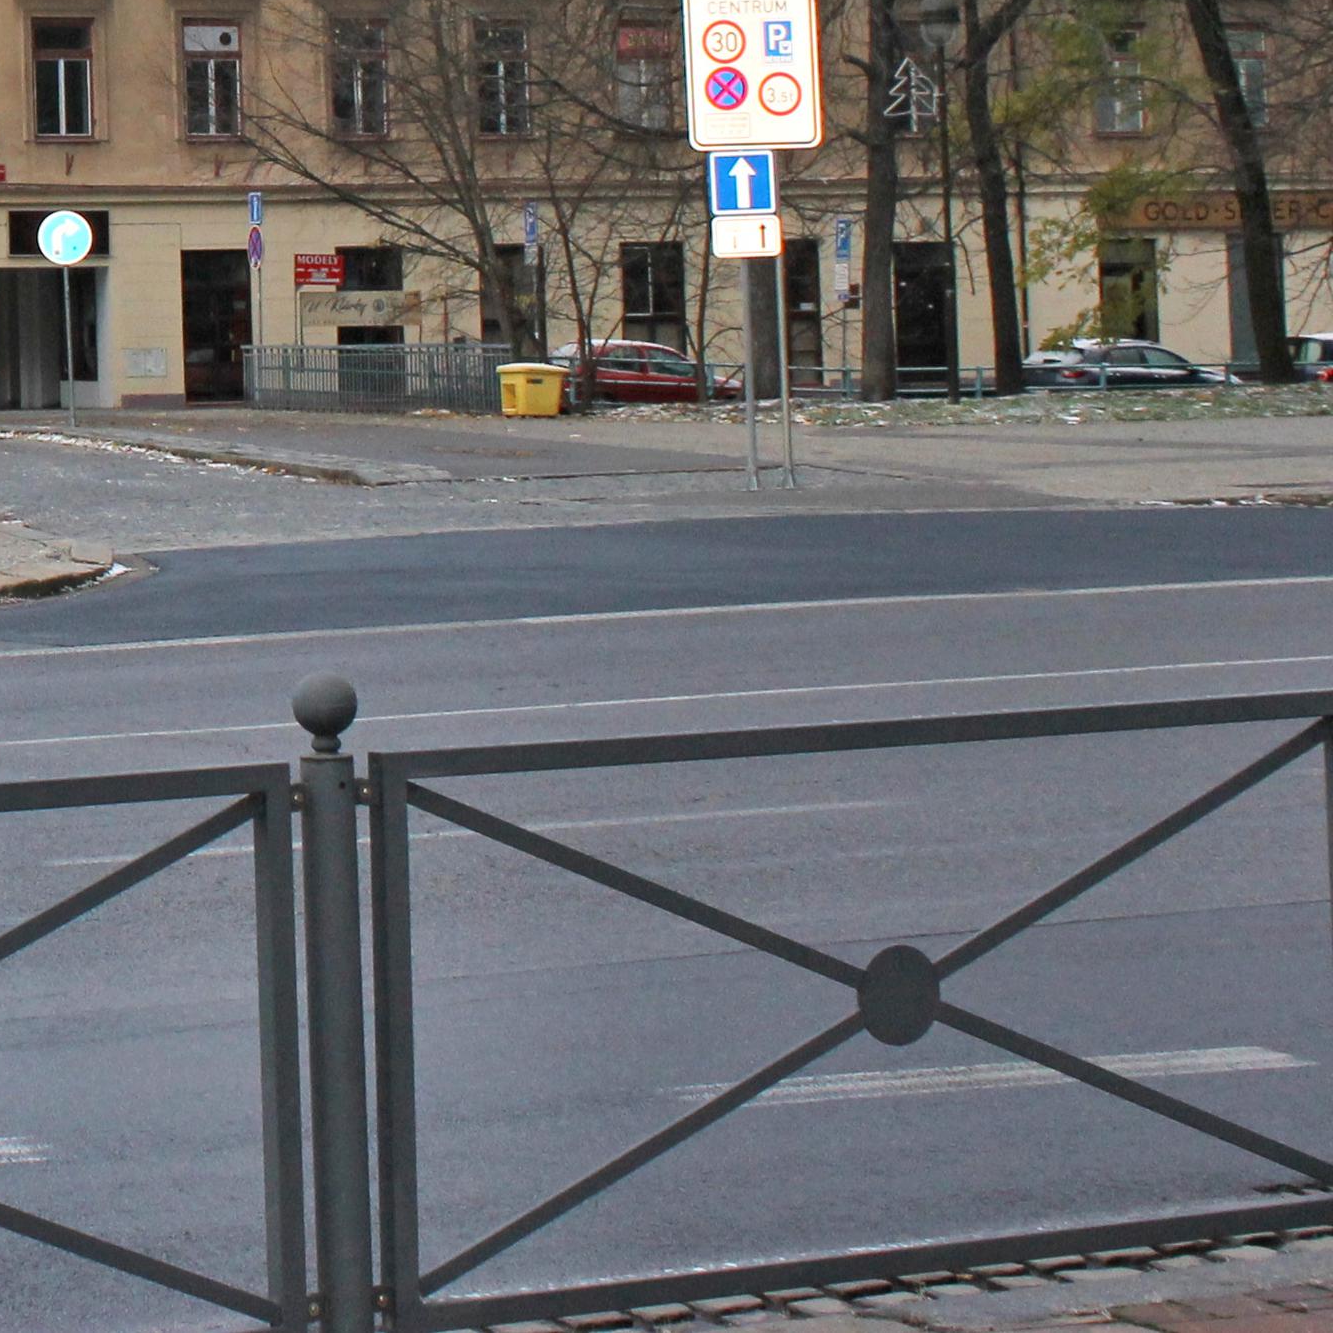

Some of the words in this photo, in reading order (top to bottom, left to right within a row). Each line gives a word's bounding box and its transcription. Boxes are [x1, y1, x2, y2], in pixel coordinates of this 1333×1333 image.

[707, 0, 787, 15] CENTRUM
[711, 32, 738, 53] 30
[1144, 202, 1209, 221] GOLD
